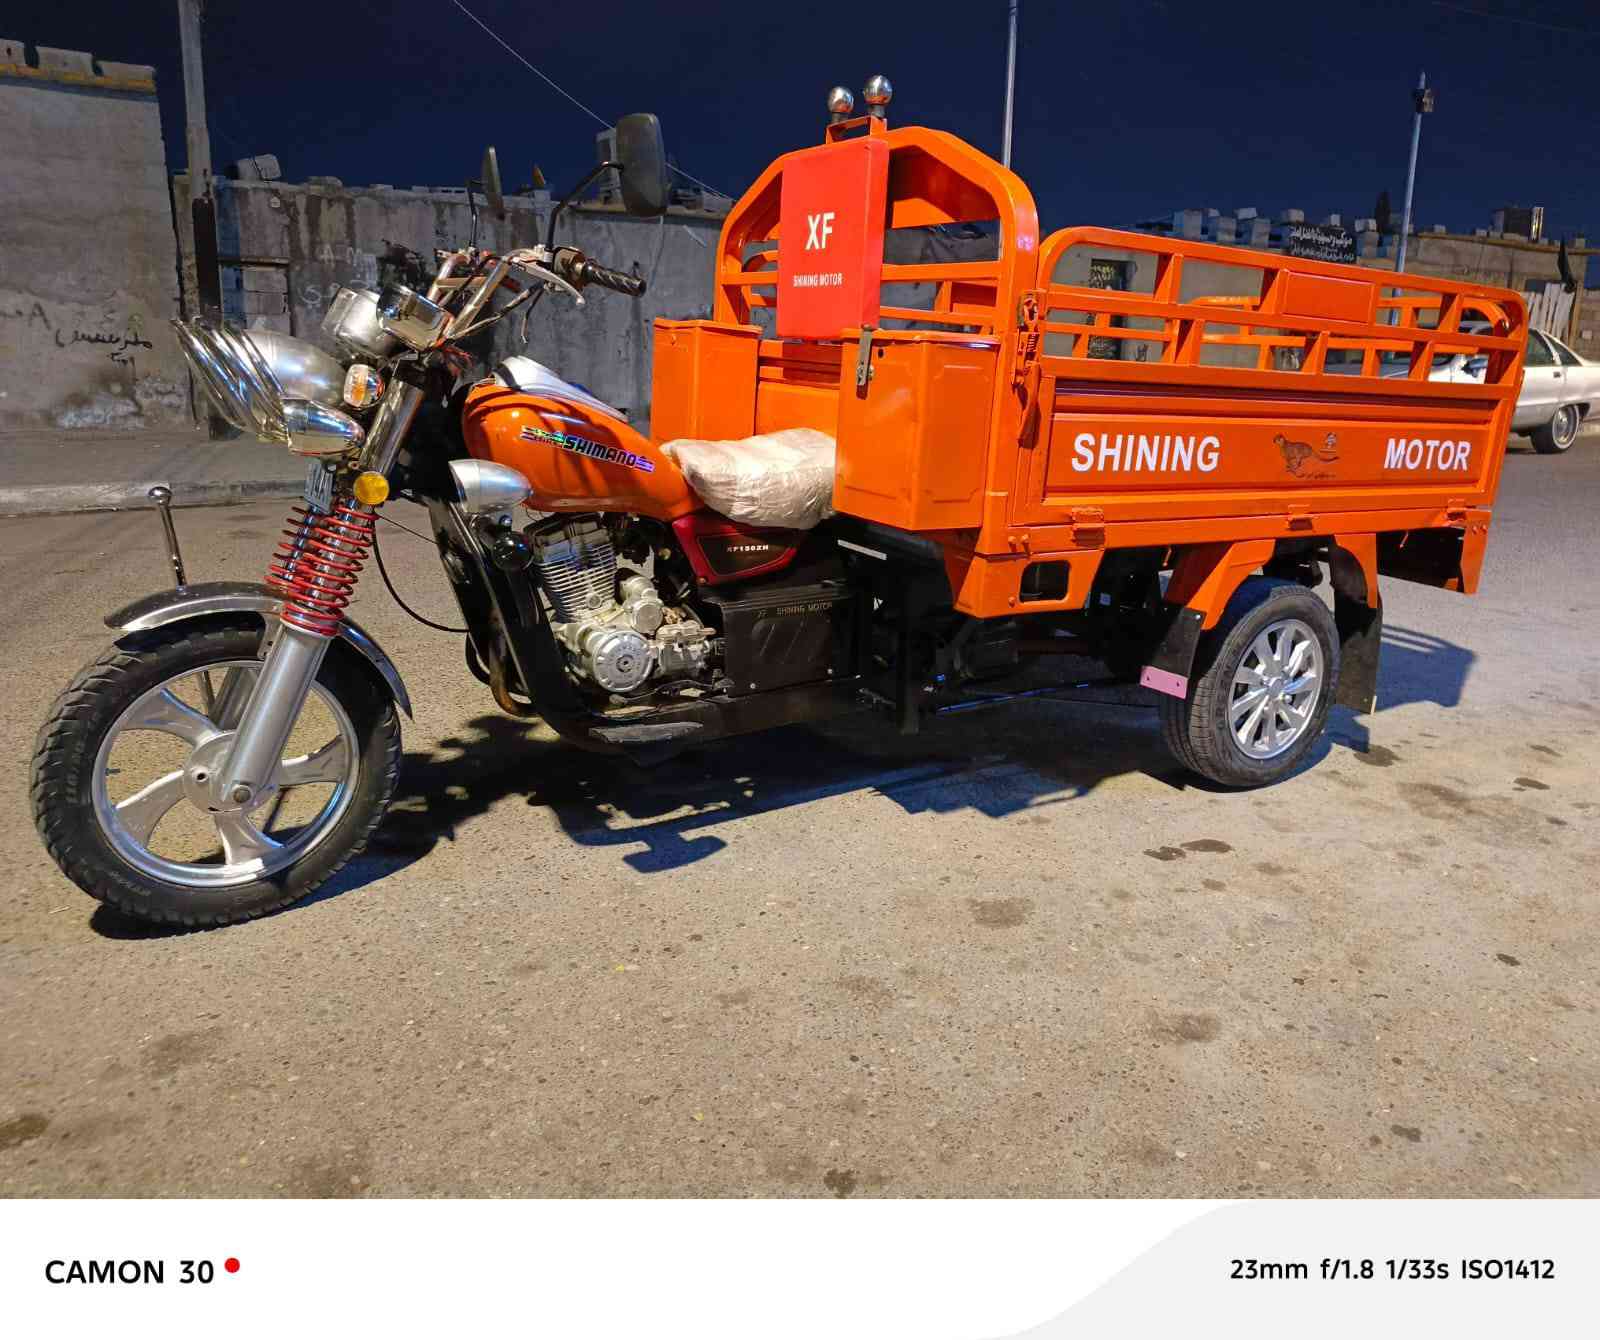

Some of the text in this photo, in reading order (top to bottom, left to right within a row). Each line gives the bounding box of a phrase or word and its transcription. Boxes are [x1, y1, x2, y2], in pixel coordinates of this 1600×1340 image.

[805, 212, 835, 250] XF
[793, 272, 842, 287] SHINING MOTOR
[562, 435, 637, 467] SHIMANO
[1071, 433, 1472, 473] SHINING MOTOR
